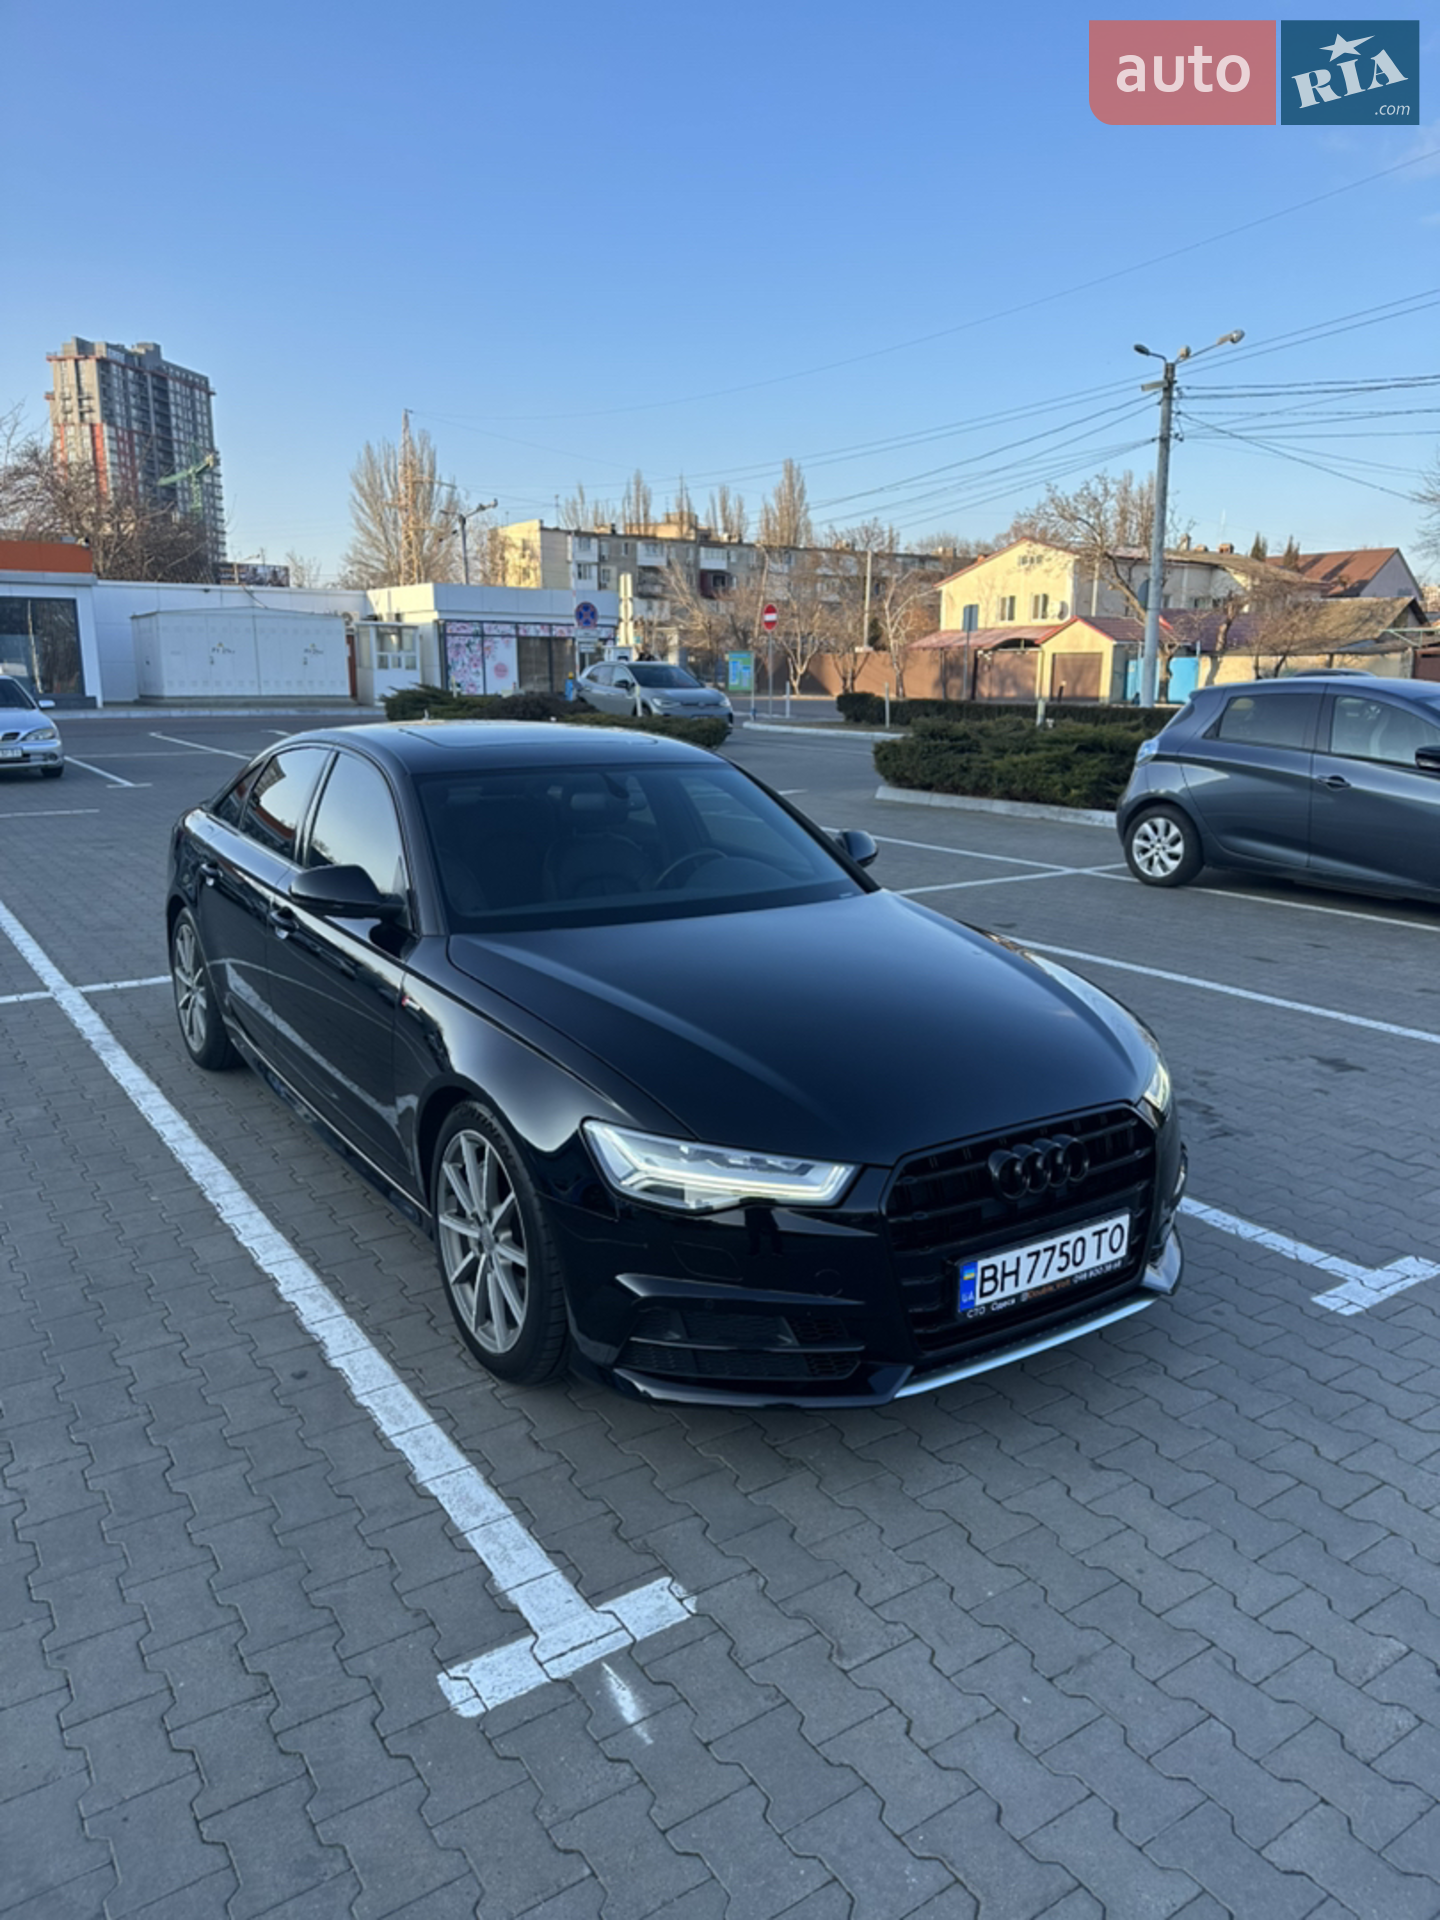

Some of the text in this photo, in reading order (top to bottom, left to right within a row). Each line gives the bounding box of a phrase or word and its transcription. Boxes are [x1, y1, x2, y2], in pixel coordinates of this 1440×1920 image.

[980, 1260, 1020, 1298] BH
[1027, 1237, 1086, 1283] 7750
[1093, 1224, 1124, 1259] TO
[961, 1291, 975, 1304] UA
